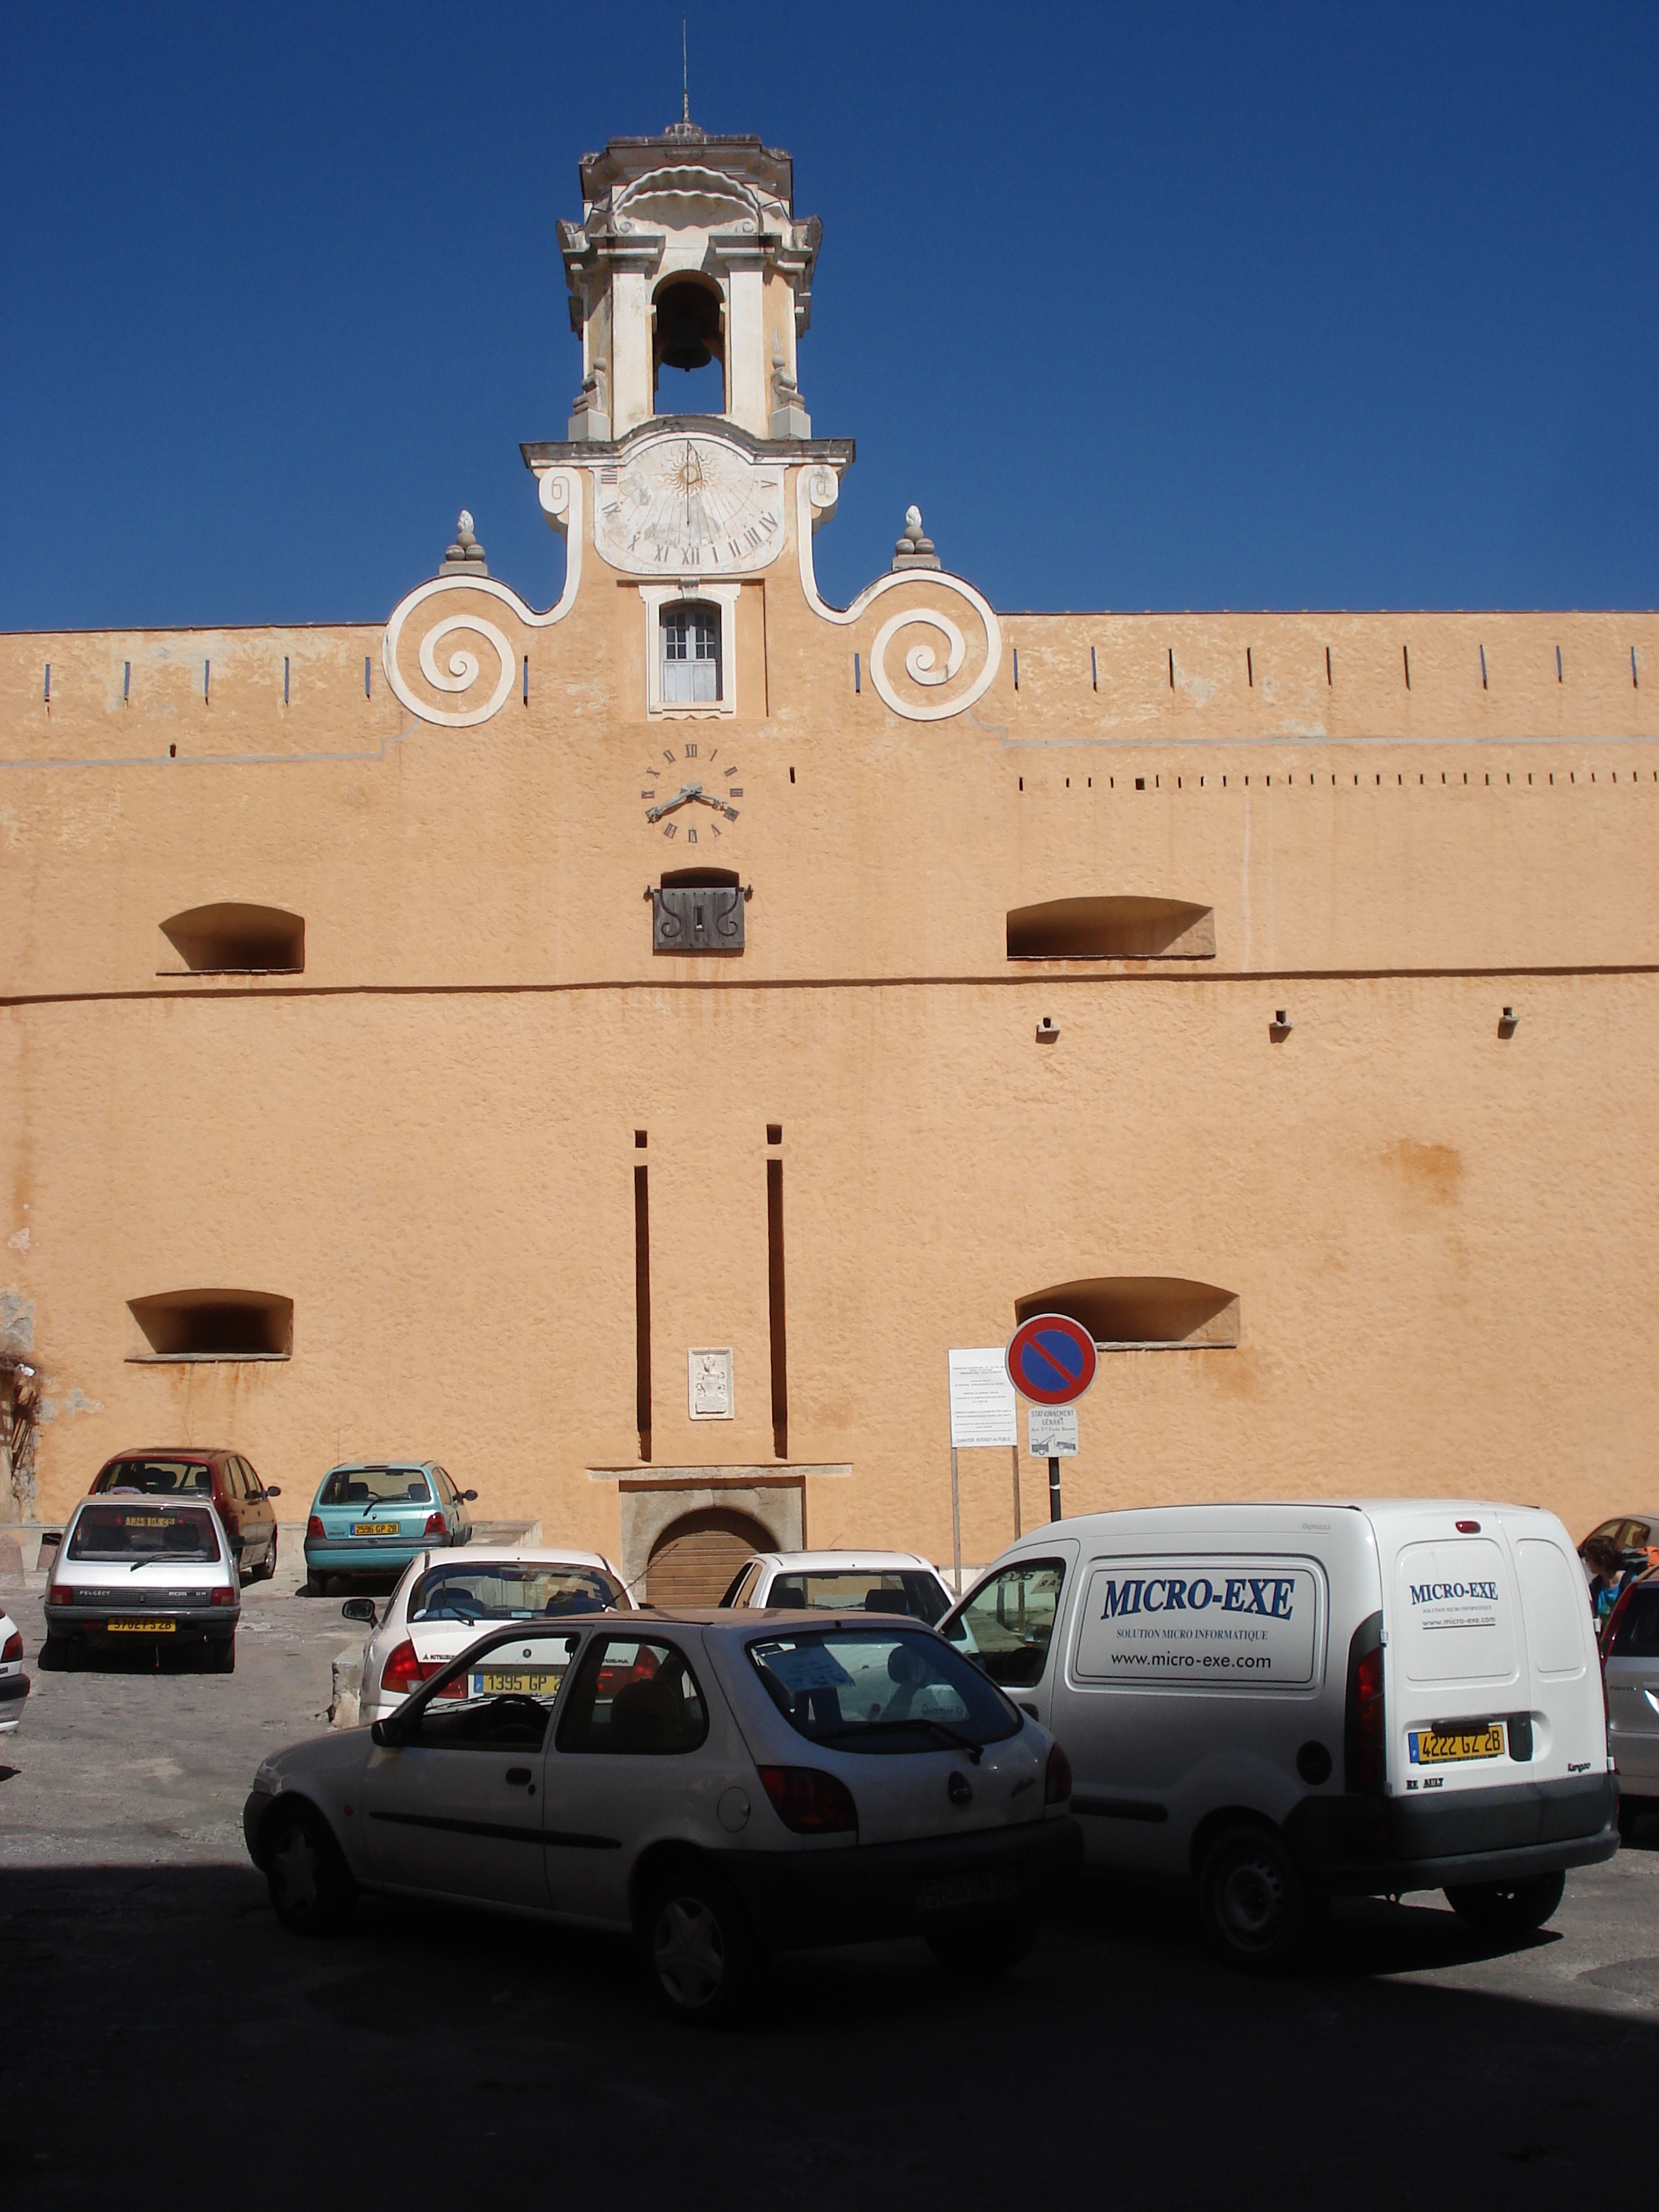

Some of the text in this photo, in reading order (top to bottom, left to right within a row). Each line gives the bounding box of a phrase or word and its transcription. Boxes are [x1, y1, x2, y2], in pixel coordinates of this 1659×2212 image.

[602, 502, 621, 518] IX
[758, 512, 778, 533] IV
[628, 534, 640, 551] X
[743, 526, 763, 548] III
[654, 544, 668, 562] XI
[681, 548, 701, 565] XII
[711, 546, 720, 563] I
[727, 539, 742, 558] II
[684, 744, 698, 758] XII
[723, 766, 738, 777] II
[730, 788, 744, 797] III
[1031, 1409, 1074, 1418] STATIONNEMENT
[356, 1525, 374, 1534] 2596
[375, 1524, 386, 1533] GP
[387, 1523, 397, 1533] 2B
[1101, 1578, 1296, 1621] MICRO-EXE
[1409, 1581, 1499, 1606] MICRO-EXE
[114, 1617, 172, 1630] 5702 FS 2B
[1422, 1617, 1496, 1626] www.micro-exe.com
[1116, 1628, 1269, 1643] SOLUTION MICRO INFORMATIQUE
[1111, 1650, 1272, 1668] www.micro-exe.com
[487, 1675, 562, 1691] 1395 GP 2
[1423, 1730, 1501, 1758] 4222 GZ 2B
[1406, 1778, 1445, 1790] REAULT
